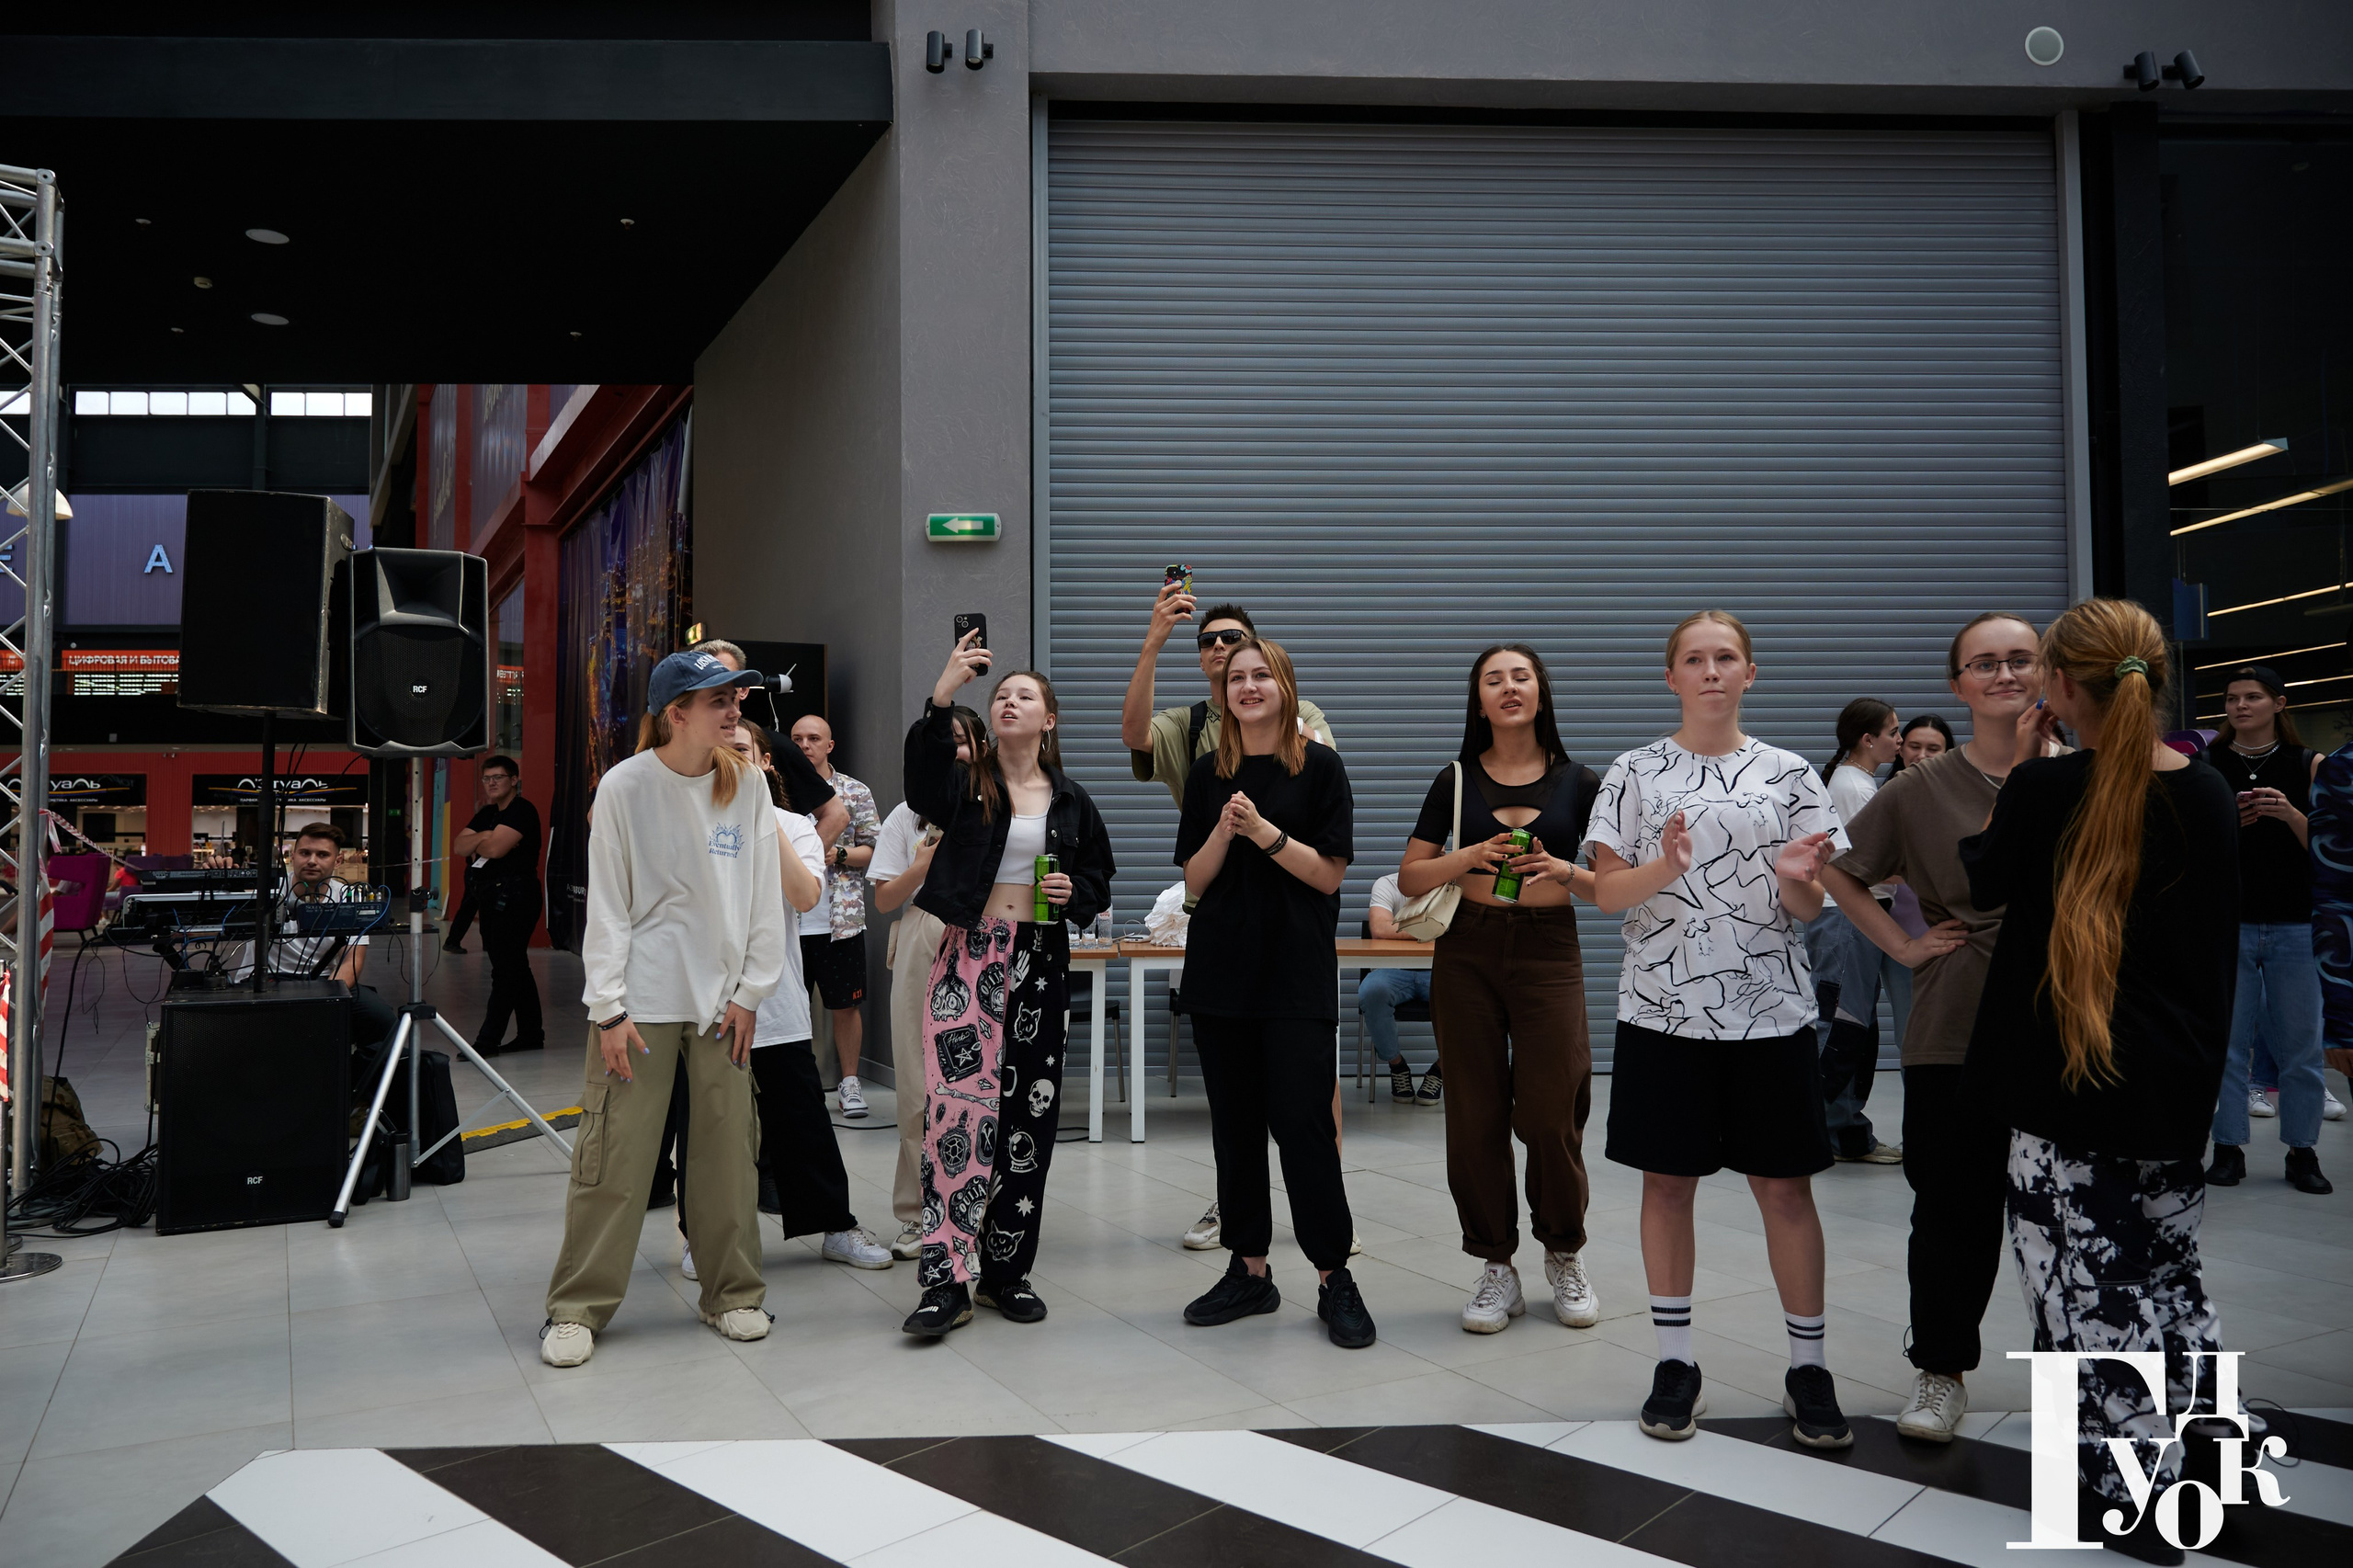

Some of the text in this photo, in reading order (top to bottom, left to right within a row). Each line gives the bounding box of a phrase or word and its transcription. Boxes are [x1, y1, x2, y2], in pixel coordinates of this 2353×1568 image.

[68, 654, 128, 666] ЦИФРОВАЯ
[130, 654, 138, 664] И
[413, 685, 428, 694] RCF
[709, 840, 742, 852] Eventually
[709, 847, 738, 858] Returned
[246, 1176, 264, 1186] RCF
[959, 1183, 987, 1213] OUIJA
